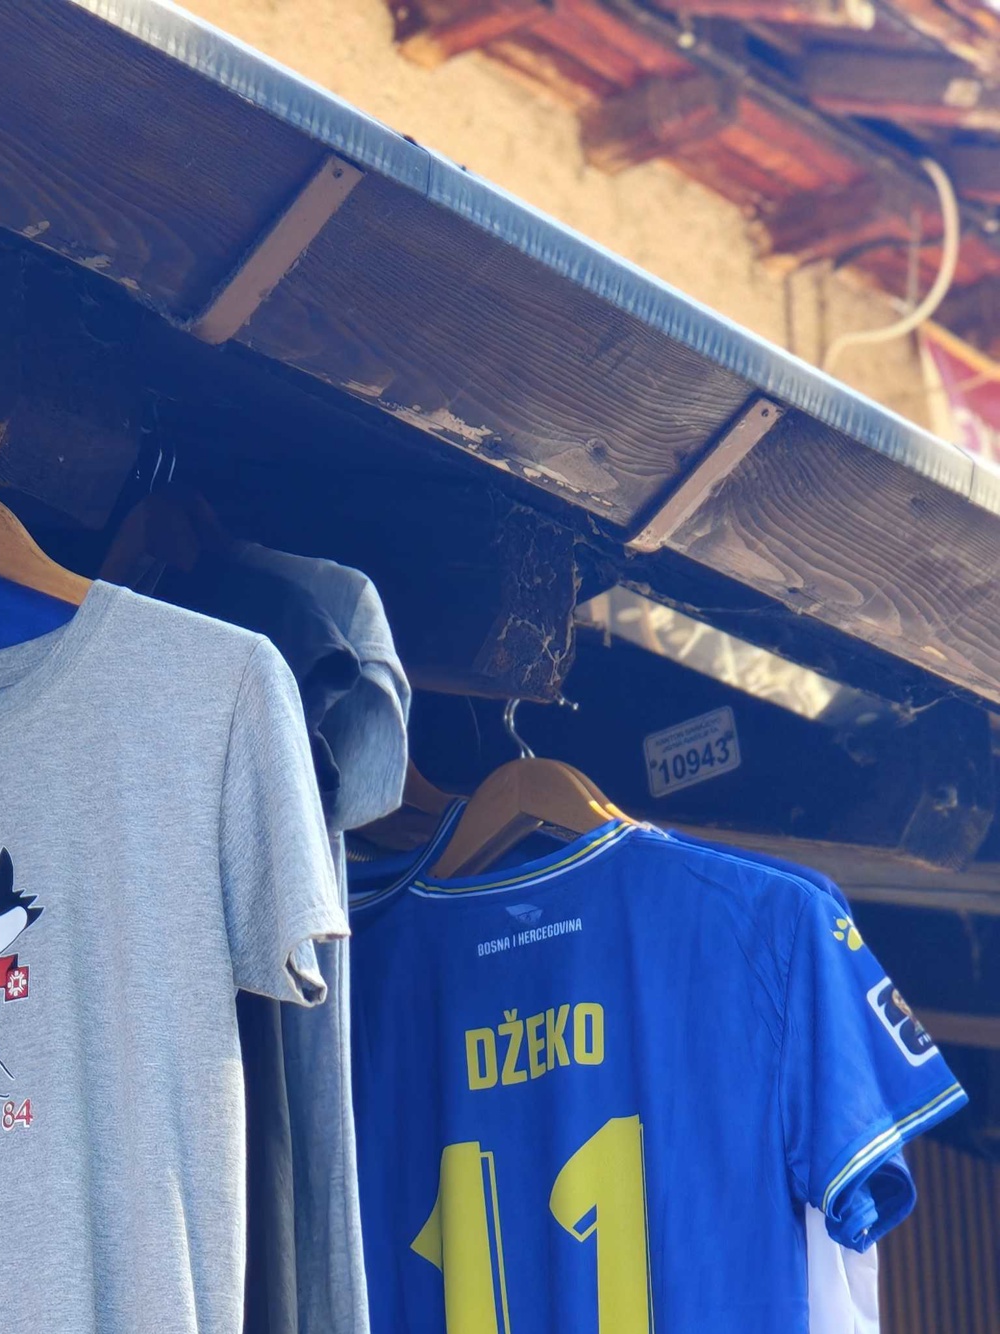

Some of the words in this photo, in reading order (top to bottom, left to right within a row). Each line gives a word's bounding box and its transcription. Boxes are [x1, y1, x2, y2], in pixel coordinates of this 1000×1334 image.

[658, 736, 730, 785] 10943
[477, 937, 510, 957] BOSNA
[518, 918, 583, 946] HERCEGOVINA
[464, 1002, 605, 1090] DŽEKO
[2, 1098, 34, 1131] 84
